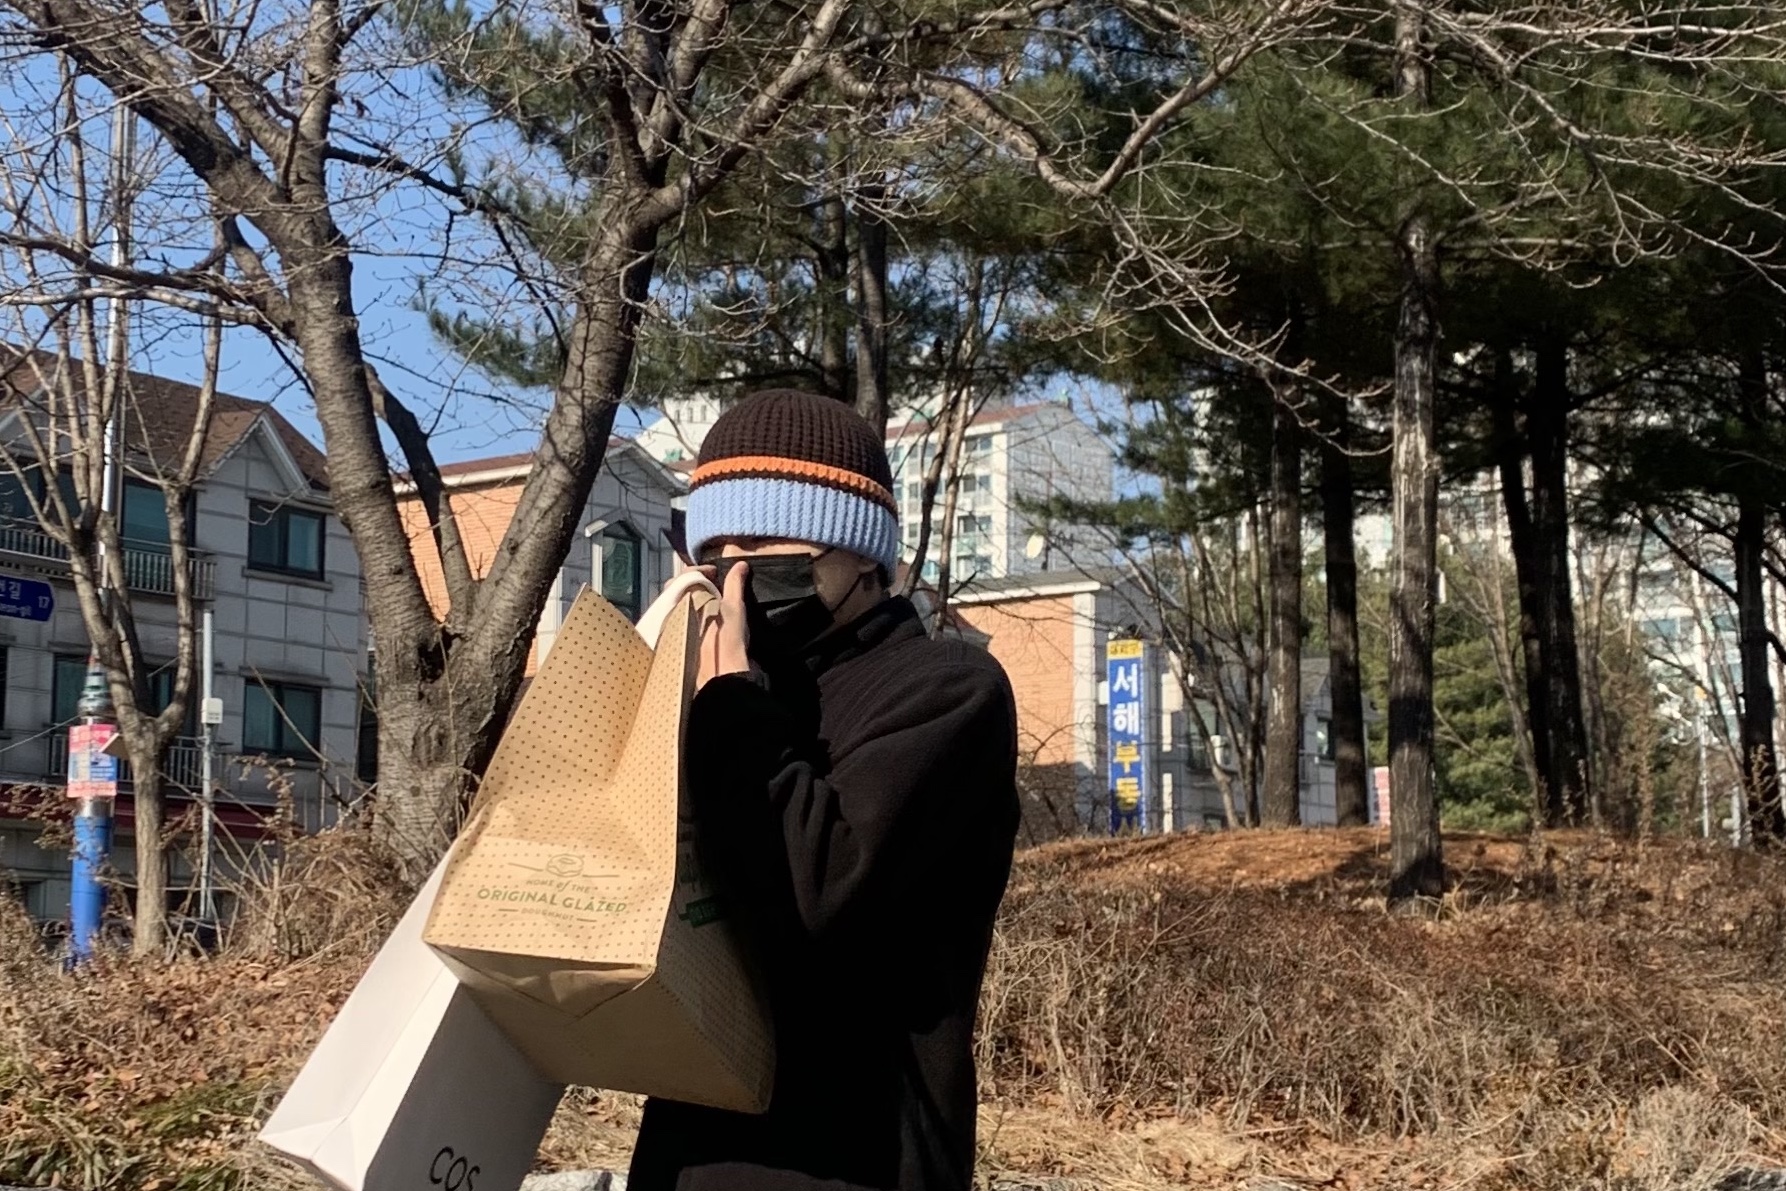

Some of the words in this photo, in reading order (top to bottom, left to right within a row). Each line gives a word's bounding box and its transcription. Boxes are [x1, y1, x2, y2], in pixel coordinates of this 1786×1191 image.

[38, 596, 50, 609] 17
[525, 878, 554, 888] HOME
[556, 880, 571, 893] of
[571, 884, 591, 894] THE
[477, 888, 558, 906] ORIGINAL
[562, 896, 628, 913] GLAZED
